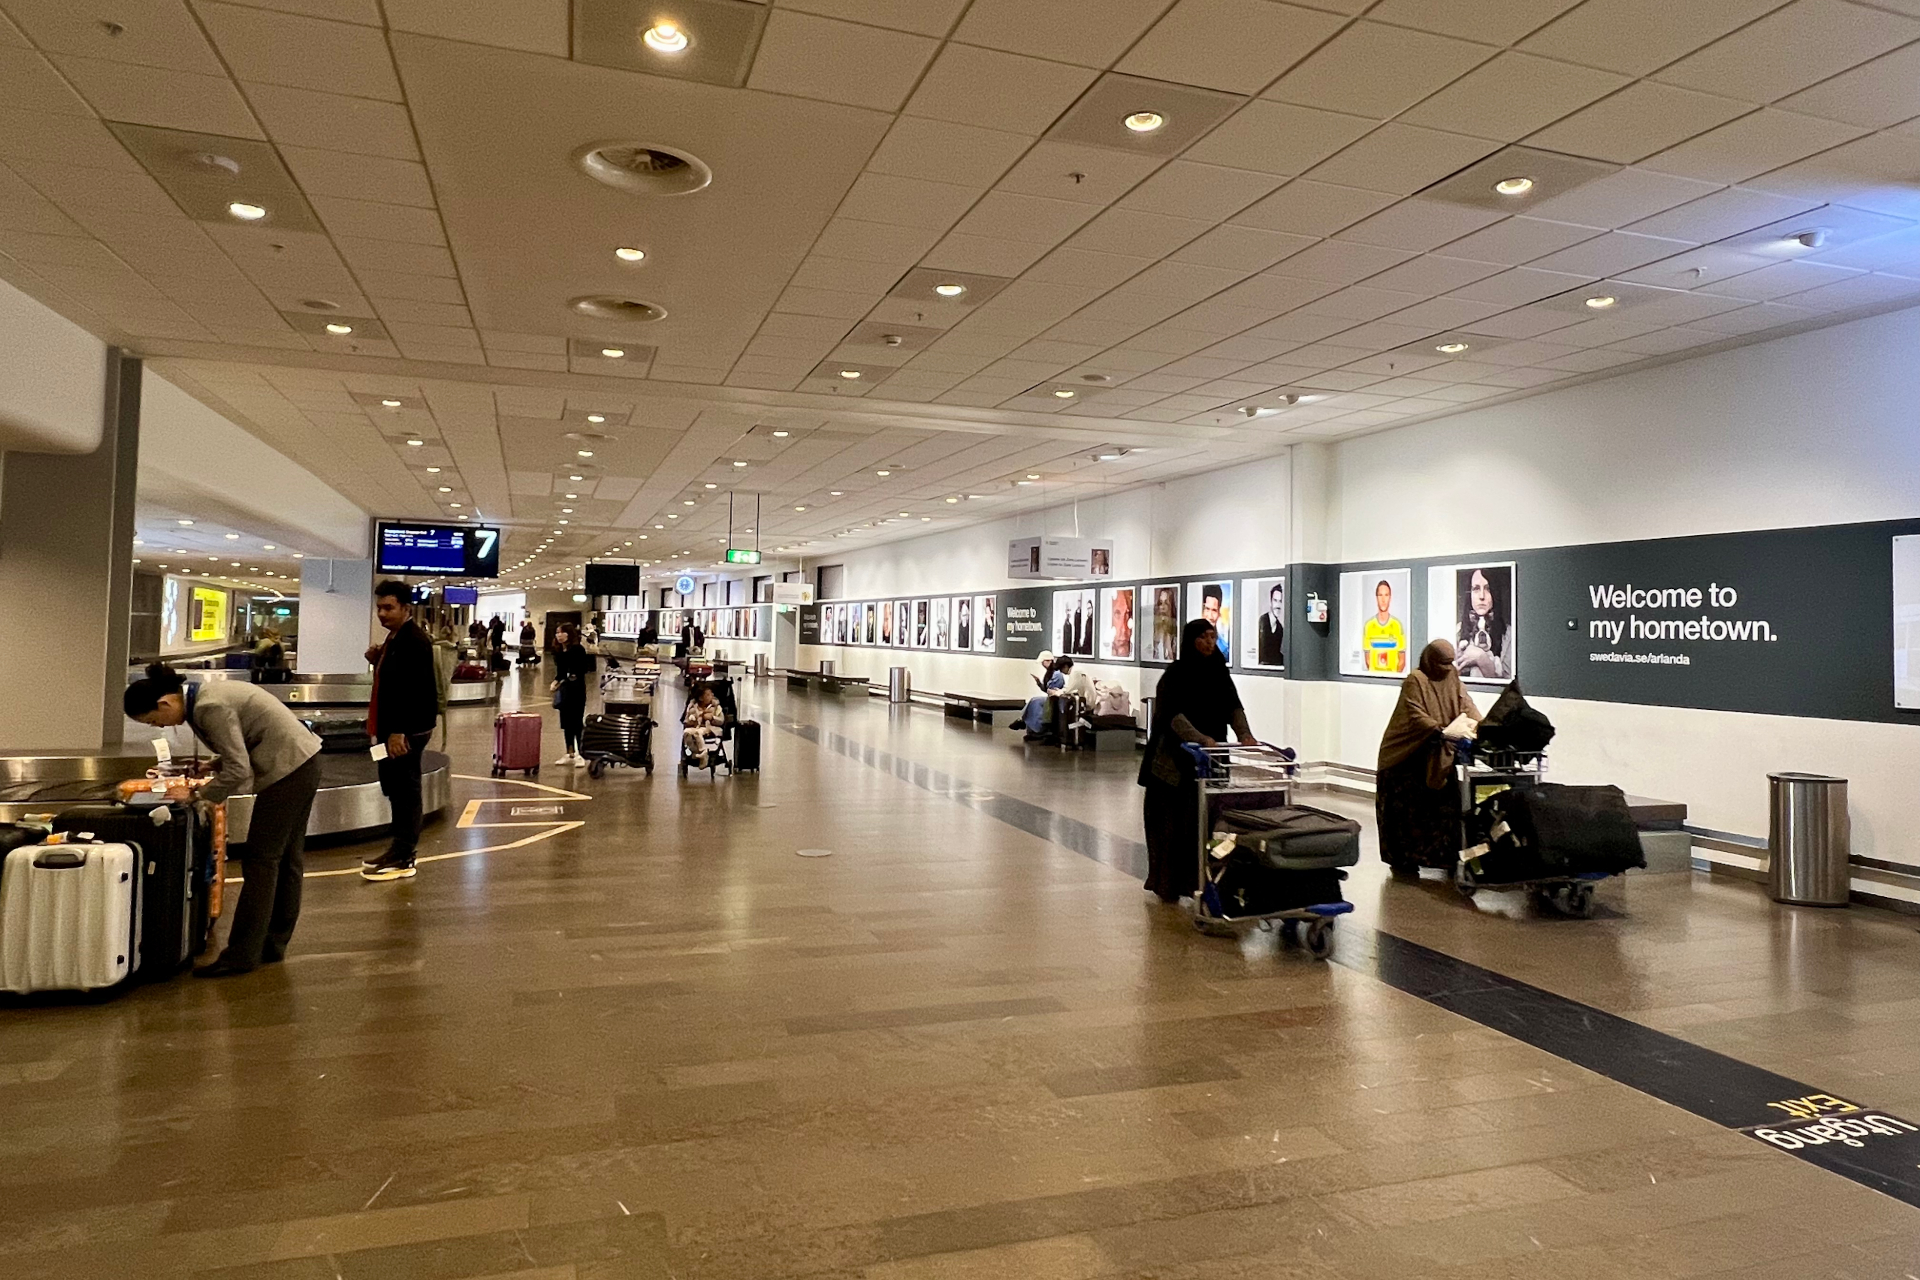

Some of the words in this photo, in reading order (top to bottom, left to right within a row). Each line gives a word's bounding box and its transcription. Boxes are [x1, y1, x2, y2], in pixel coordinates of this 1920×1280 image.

[474, 530, 498, 559] 7
[1589, 584, 1703, 609] Welcome
[1708, 582, 1738, 608] to
[1589, 620, 1625, 645] my
[1630, 614, 1778, 642] hometown.
[1589, 652, 1690, 666] swedavia.se/arlanda
[1766, 1094, 1860, 1119] Exit
[1754, 1115, 1919, 1150] Utgång
